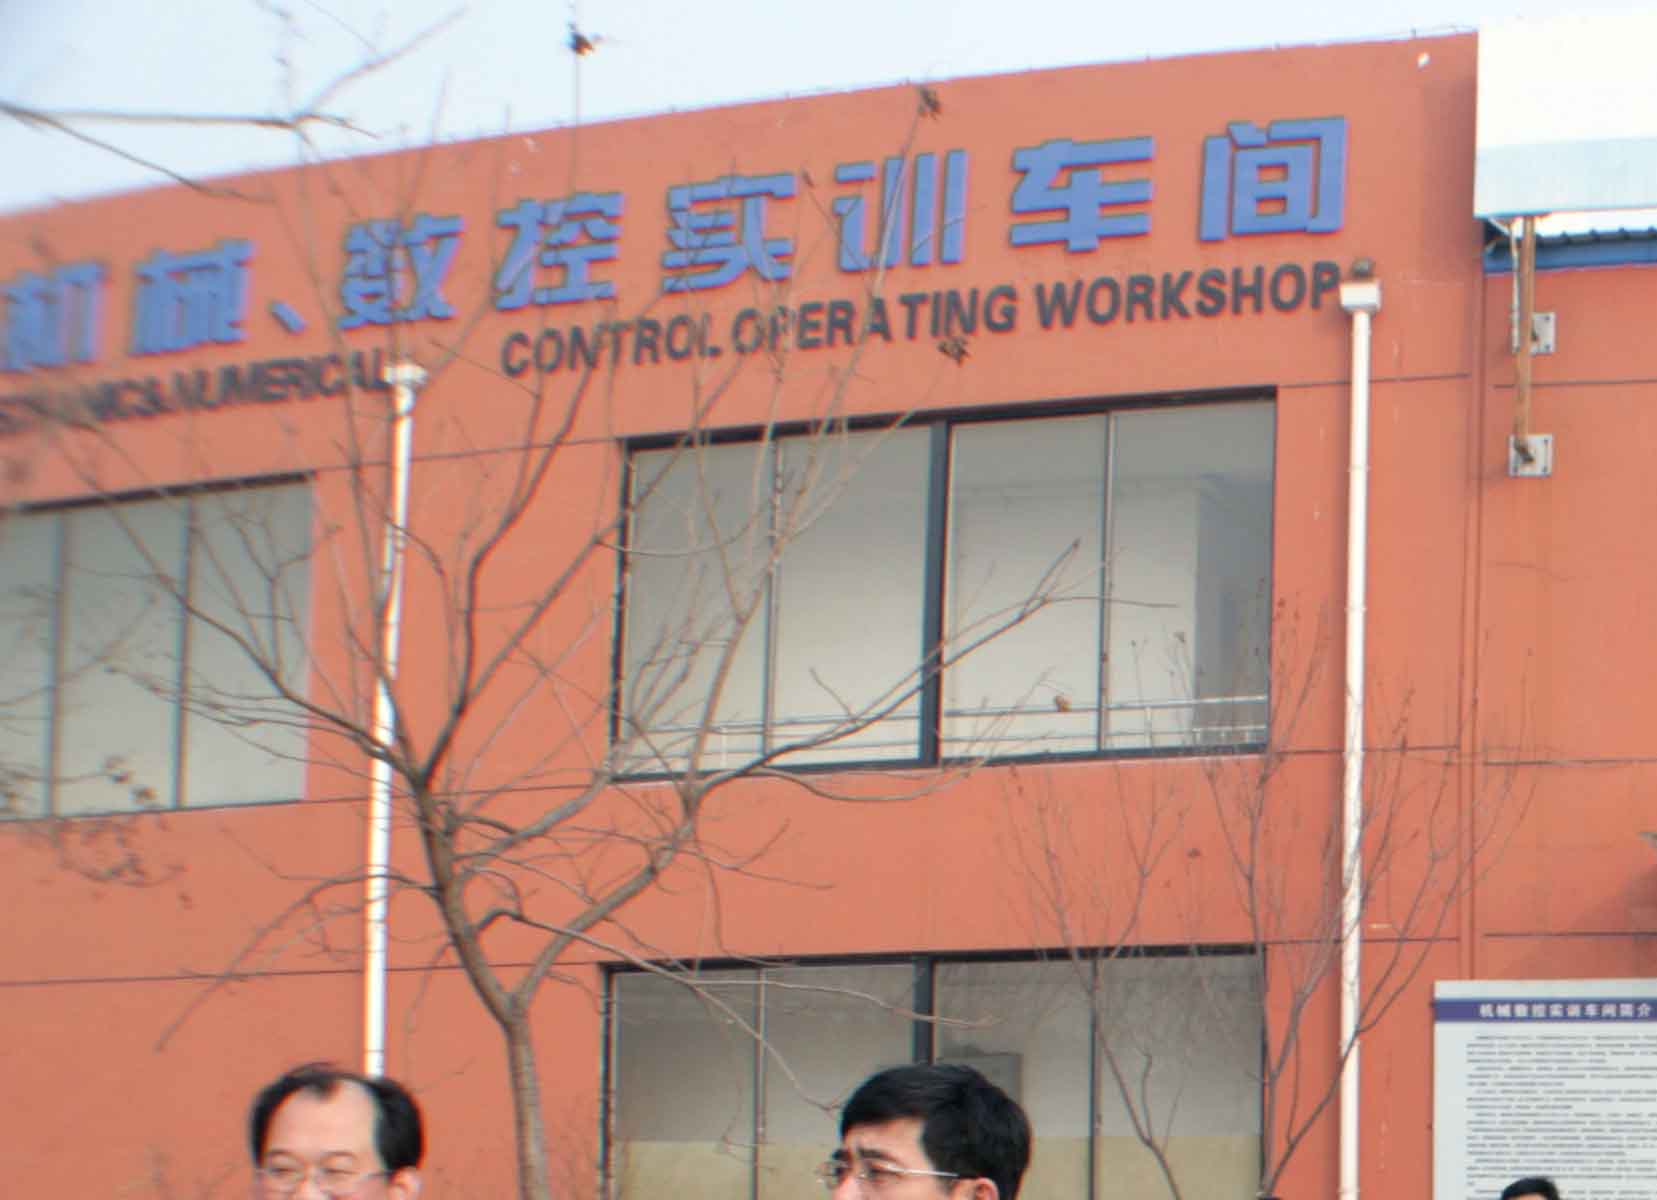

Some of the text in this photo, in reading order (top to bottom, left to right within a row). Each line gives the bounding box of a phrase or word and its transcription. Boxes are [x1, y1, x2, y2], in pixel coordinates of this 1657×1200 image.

[502, 312, 721, 378] CONTROL
[731, 283, 1018, 354] OPERATING
[1036, 261, 1341, 330] WORKSHOP
